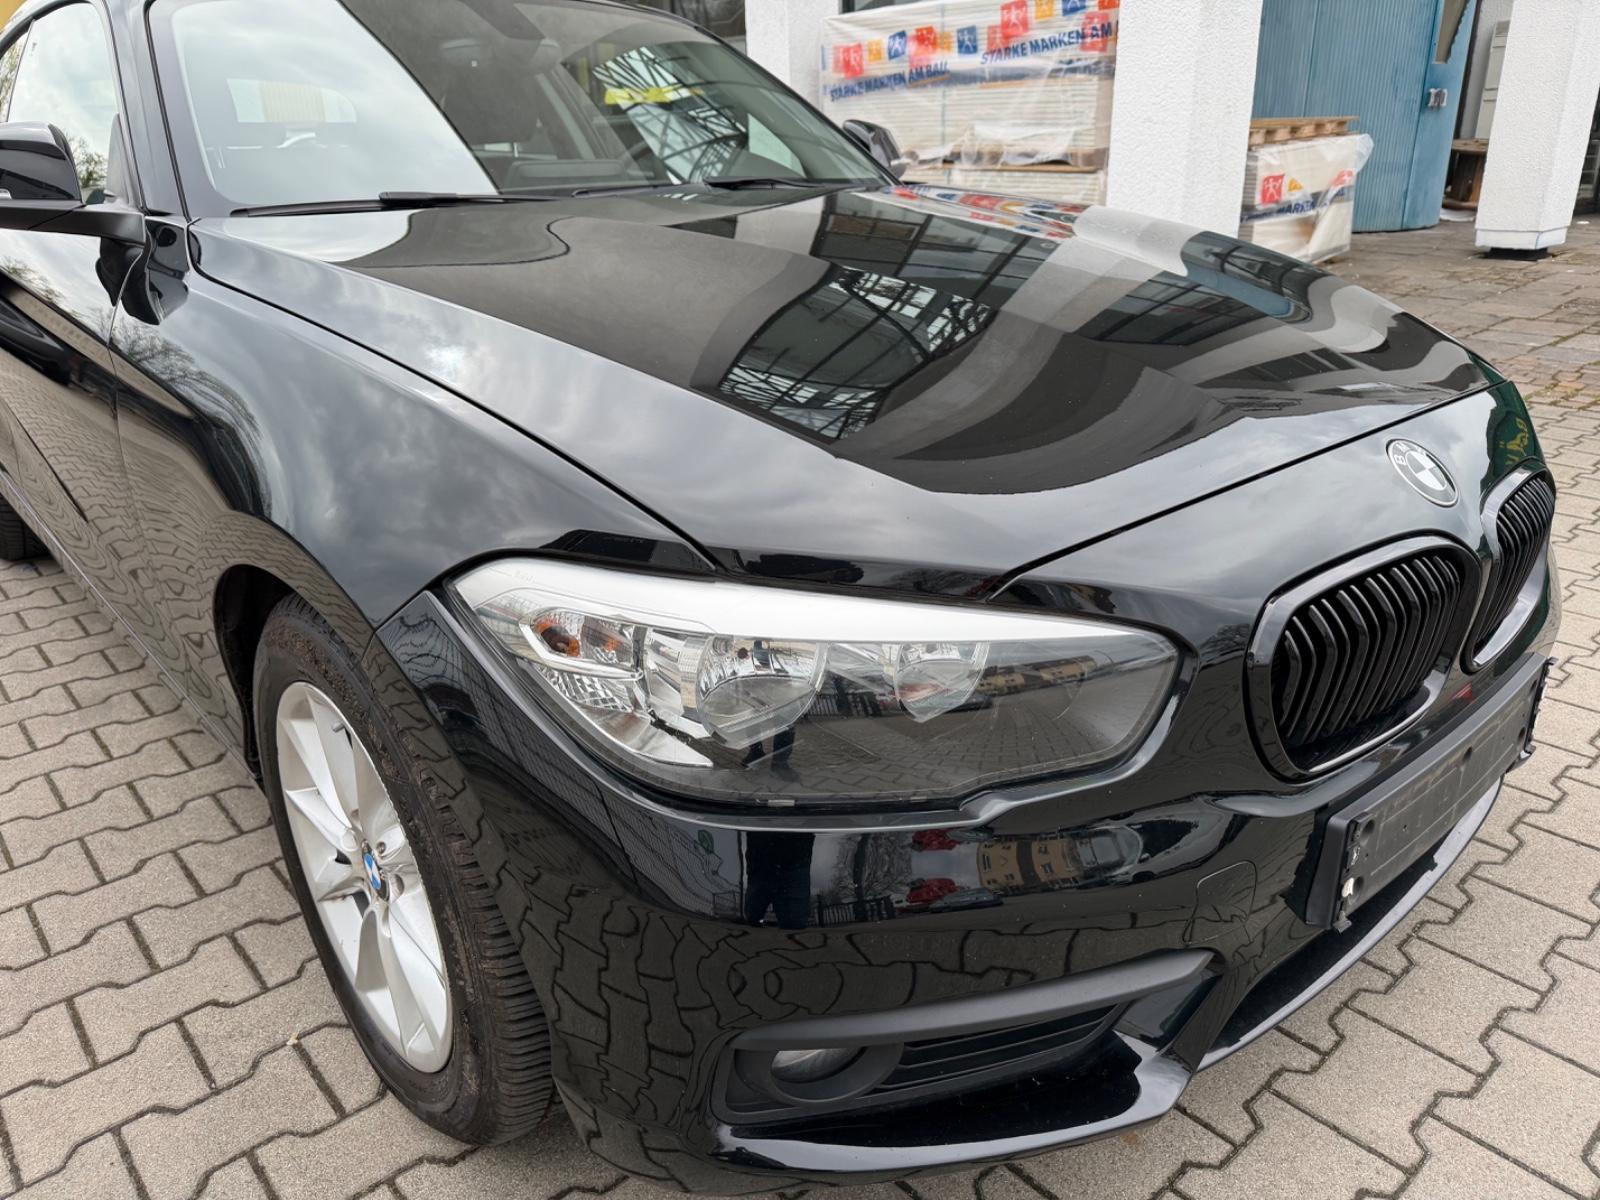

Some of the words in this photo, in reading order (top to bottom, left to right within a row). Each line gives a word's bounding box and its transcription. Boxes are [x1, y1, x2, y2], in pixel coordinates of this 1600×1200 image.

[980, 42, 1028, 65] STARKE
[1029, 27, 1087, 56] MARKEN
[1090, 22, 1113, 40] AM
